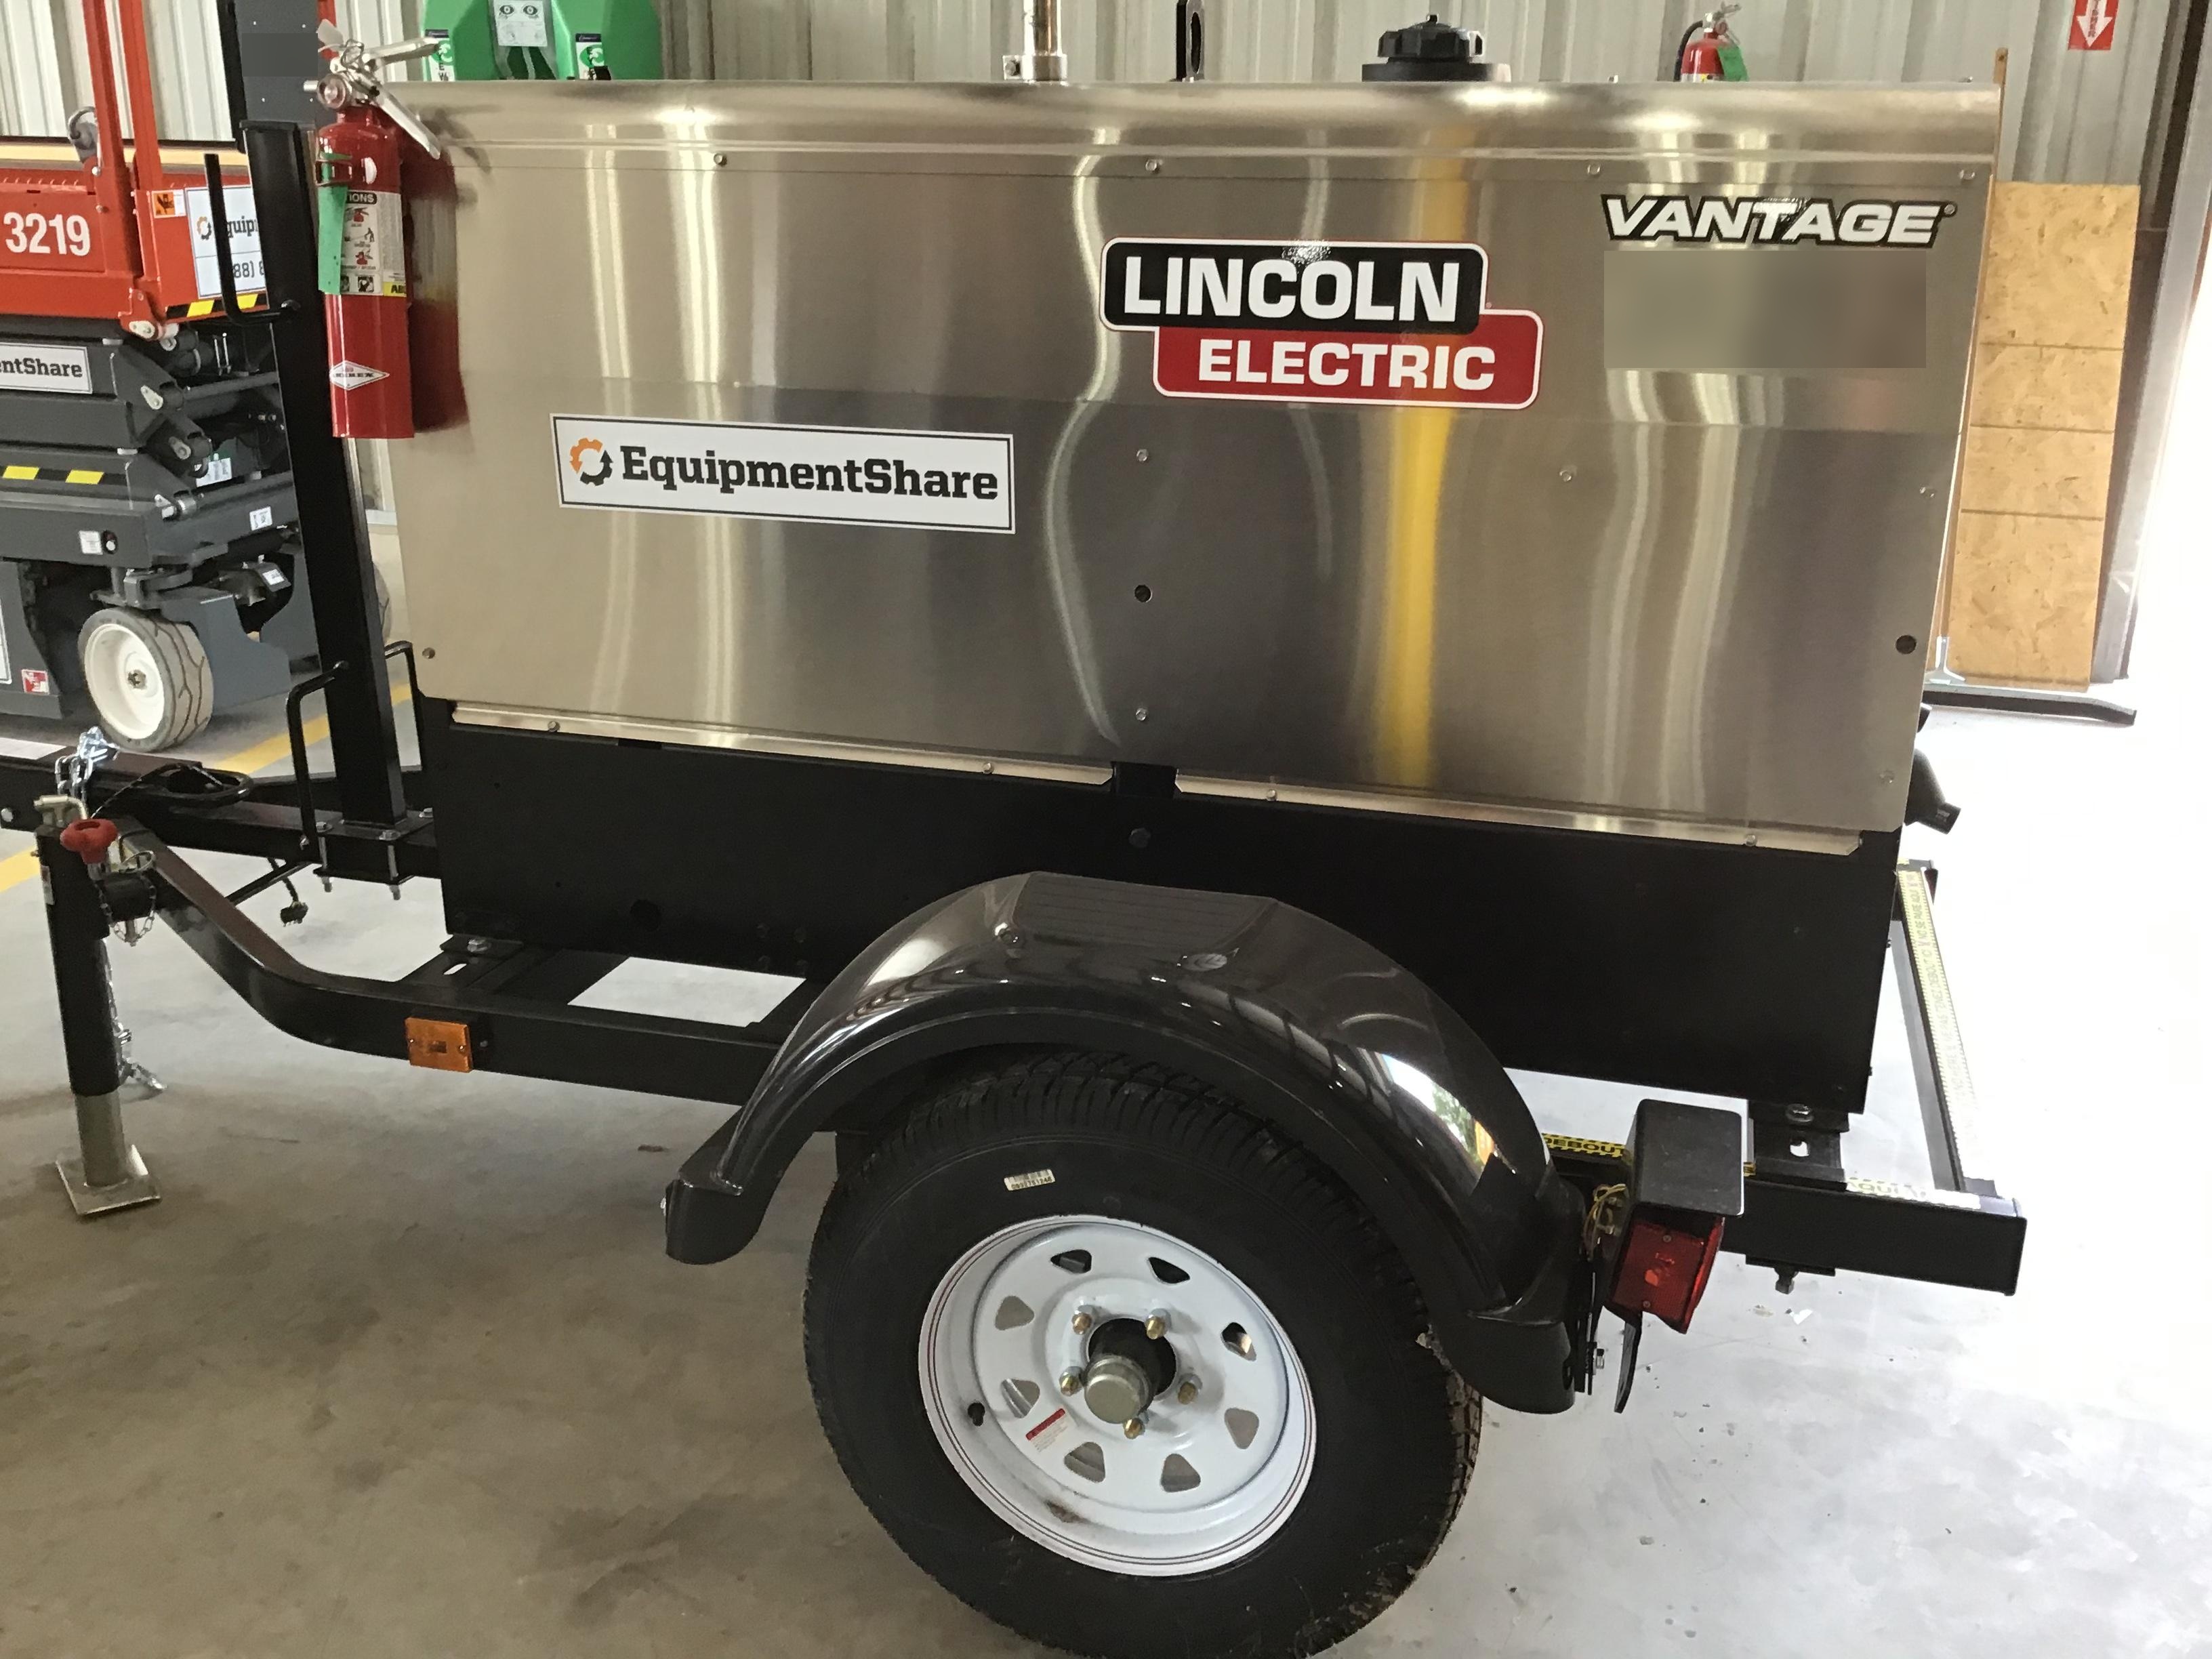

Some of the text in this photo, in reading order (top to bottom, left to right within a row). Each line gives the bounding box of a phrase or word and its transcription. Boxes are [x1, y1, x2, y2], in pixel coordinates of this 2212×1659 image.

[348, 192, 375, 203] IONS
[1603, 196, 1944, 246] VANTAGE
[3, 211, 91, 256] 3219
[227, 215, 259, 238] quip
[1124, 255, 1460, 323] LINCOLN
[0, 357, 83, 377] ntShare
[1199, 338, 1496, 391] ELECTRIC
[619, 445, 998, 500] EquipmentShare
